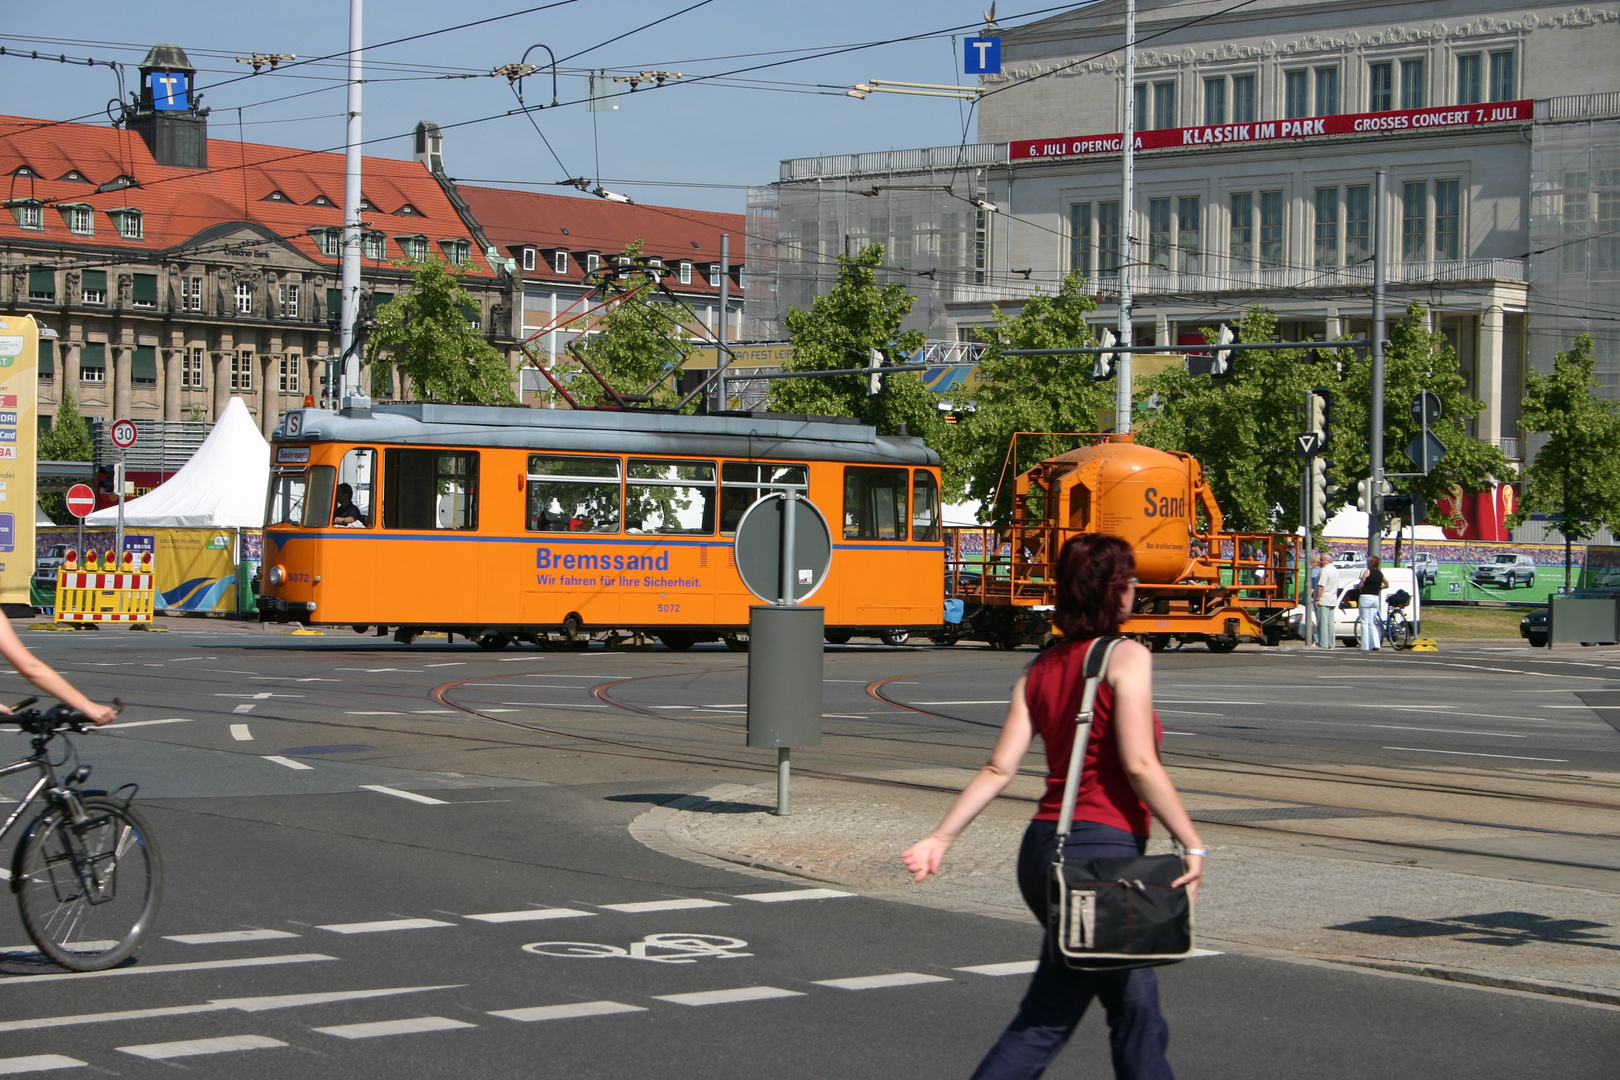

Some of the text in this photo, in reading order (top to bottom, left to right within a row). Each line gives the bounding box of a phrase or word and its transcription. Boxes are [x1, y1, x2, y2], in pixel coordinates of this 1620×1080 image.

[973, 42, 992, 69] T
[159, 77, 177, 105] T
[1353, 106, 1517, 132] GROSSES CONCERT 7. JULI
[1183, 118, 1326, 144] KLASSIK IM PARK
[1029, 136, 1143, 156] 6. JULI OPERNGA
[751, 349, 773, 360] FEST
[775, 349, 794, 360] LEIP
[116, 427, 132, 440] 30
[290, 416, 298, 433] S
[1143, 487, 1185, 518] Sand
[536, 548, 669, 571] Bremssand
[287, 572, 310, 583] 5072
[537, 574, 702, 588] Wir fahren für Ihre Sicherheit.
[657, 604, 681, 613] 5072
